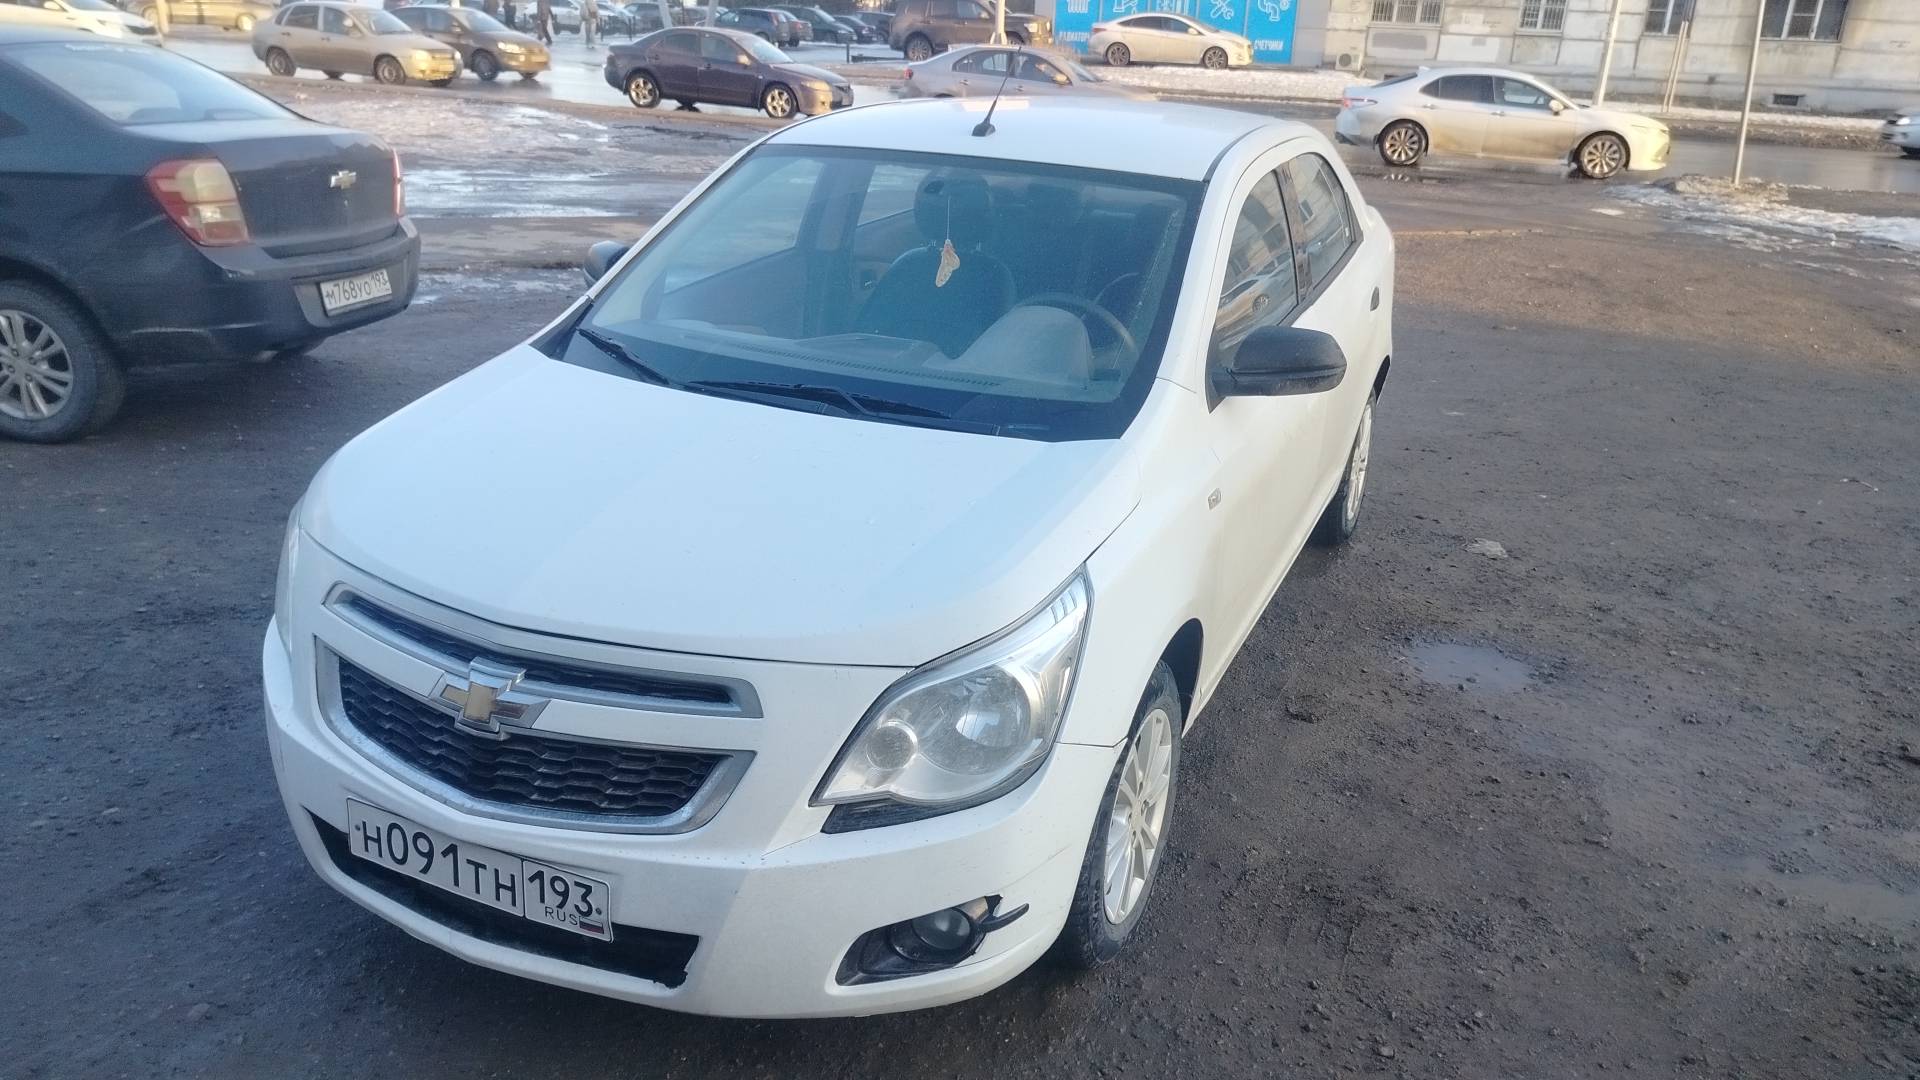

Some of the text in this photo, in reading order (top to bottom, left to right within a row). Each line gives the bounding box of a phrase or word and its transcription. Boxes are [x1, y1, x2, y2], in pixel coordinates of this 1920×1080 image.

[1059, 31, 1090, 42] РАДИАТОР
[370, 271, 387, 289] 193
[361, 820, 594, 918] Н091ТН 193
[544, 905, 578, 927] RUS
